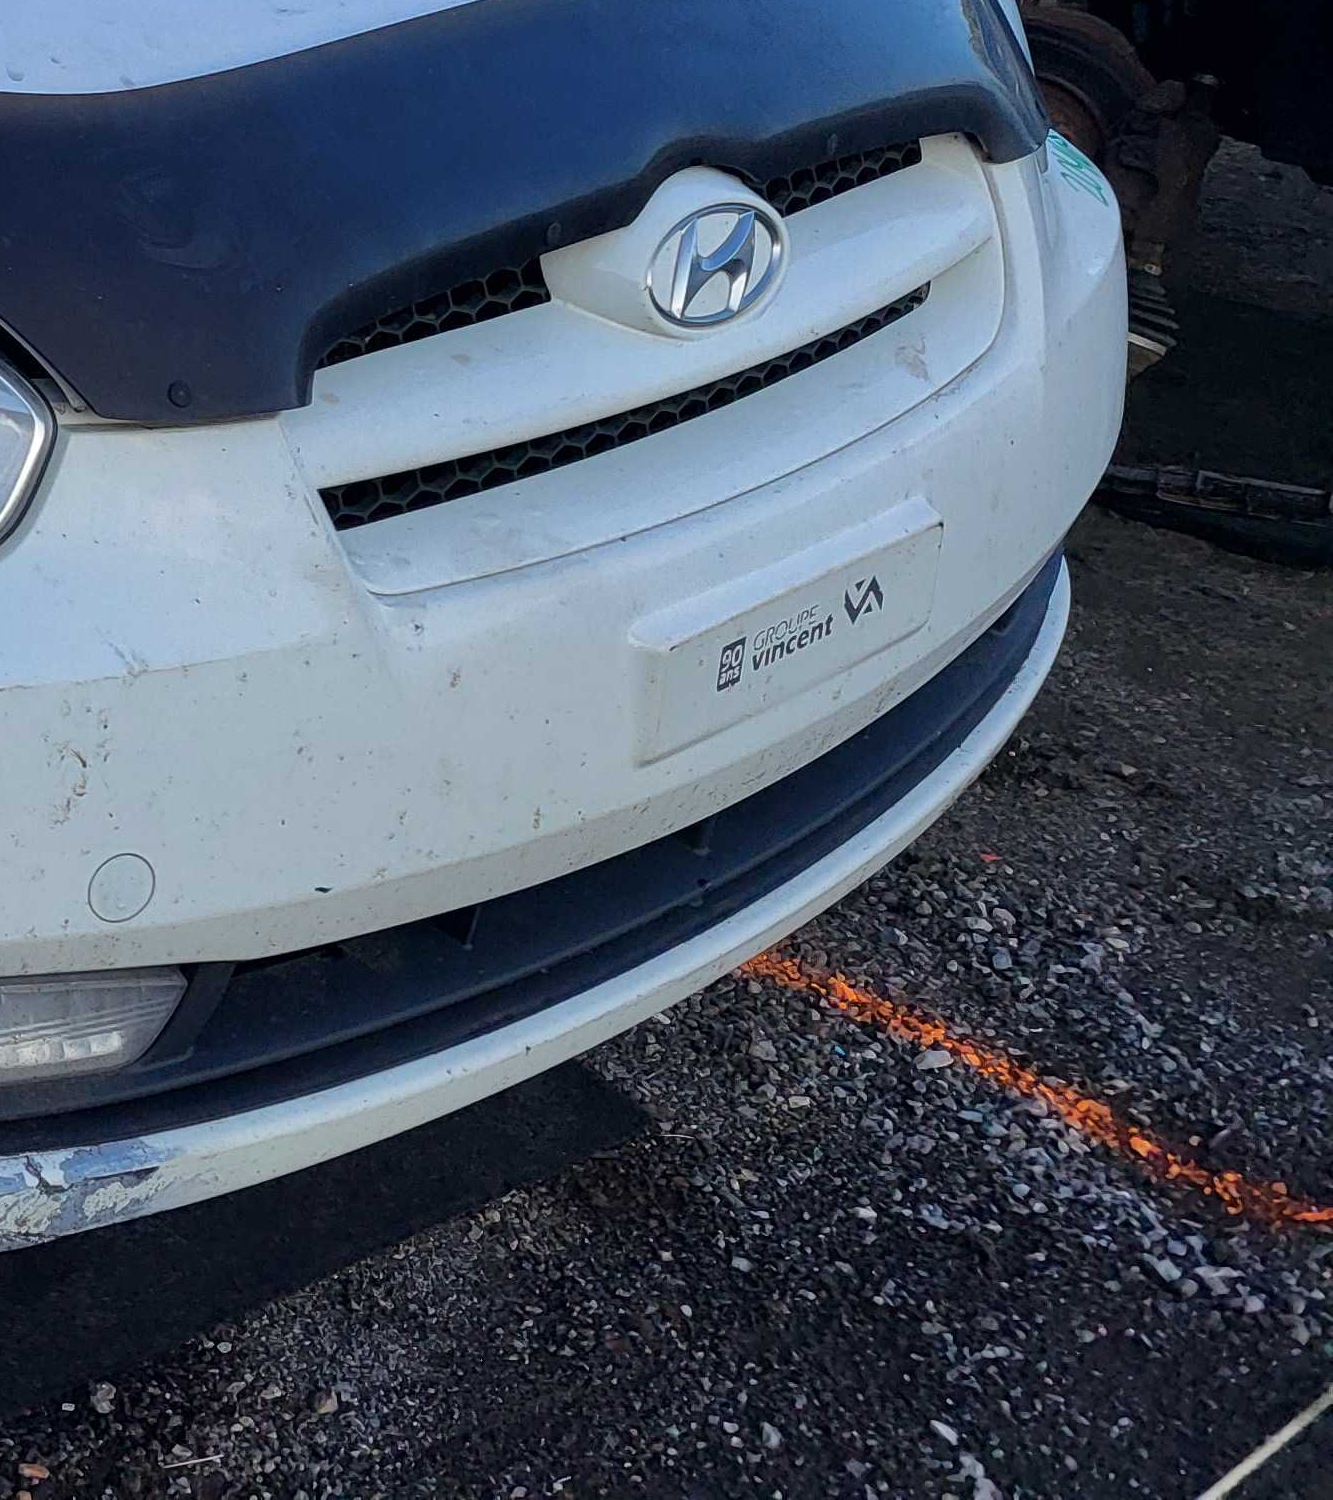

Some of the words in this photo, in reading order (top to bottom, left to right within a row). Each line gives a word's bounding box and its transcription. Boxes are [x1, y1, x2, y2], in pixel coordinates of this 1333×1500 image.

[751, 613, 834, 671] vincent
[753, 604, 820, 651] GROUPE
[721, 643, 744, 672] 90
